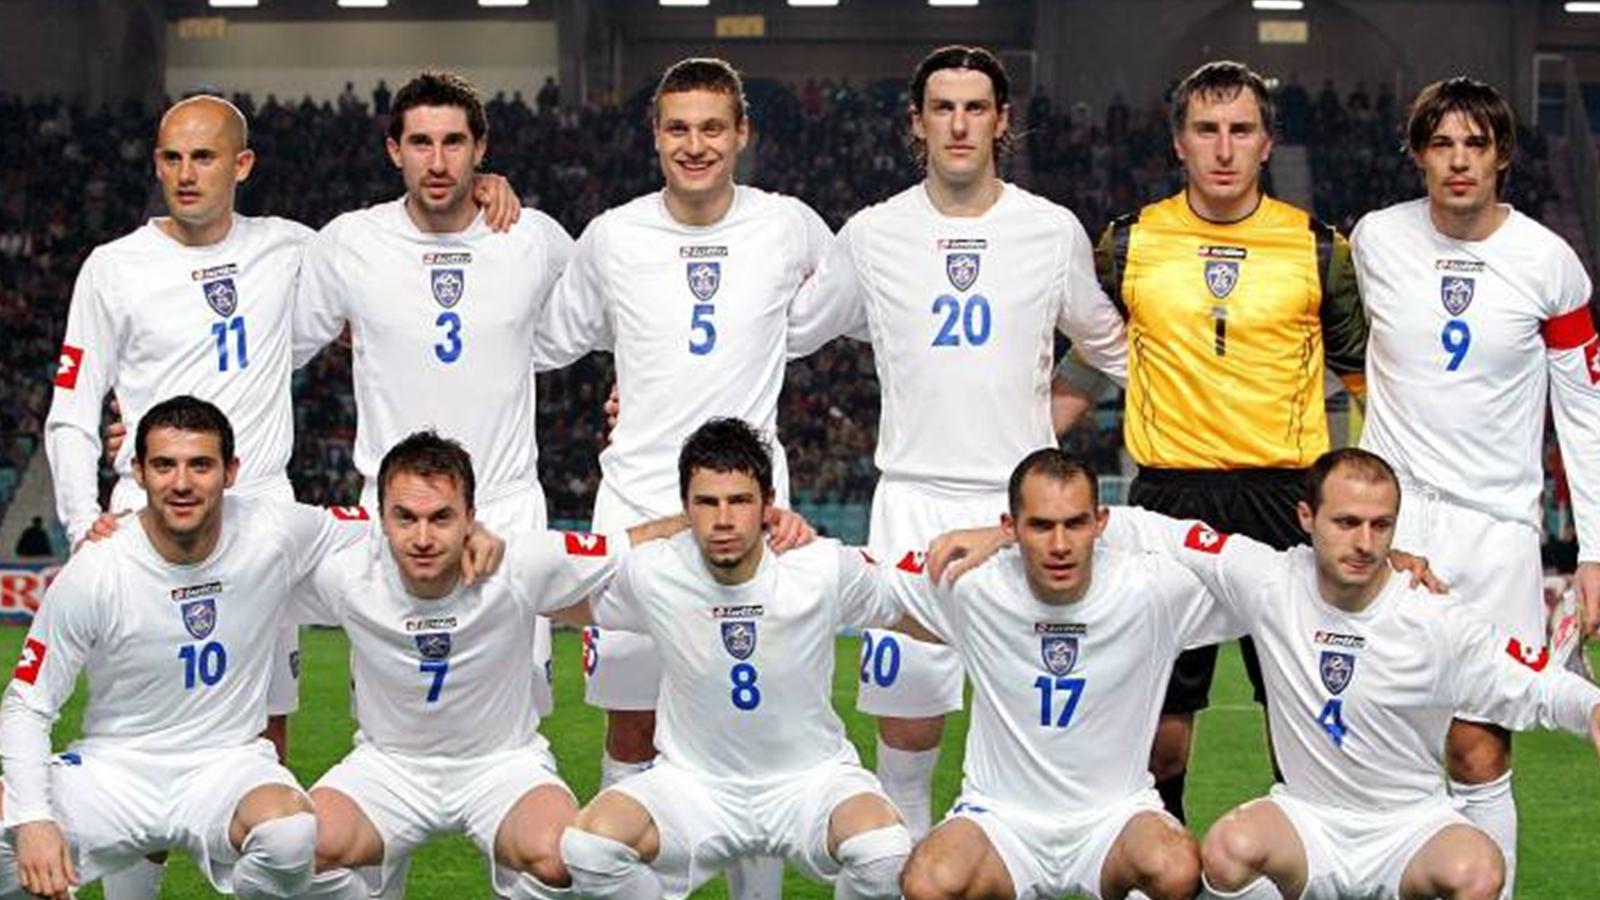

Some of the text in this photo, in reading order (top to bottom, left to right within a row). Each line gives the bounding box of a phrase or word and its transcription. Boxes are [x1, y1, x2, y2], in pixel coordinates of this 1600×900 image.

[211, 316, 248, 372] 11
[435, 312, 462, 364] 3
[690, 305, 716, 355] 5
[932, 297, 990, 346] 20
[1211, 306, 1228, 356] 1
[1441, 320, 1471, 372] 9
[178, 641, 226, 689] 10
[419, 660, 449, 703] 7
[860, 631, 900, 687] 20
[730, 663, 761, 711] 8
[1035, 675, 1086, 728] 17
[1317, 699, 1348, 746] 4
